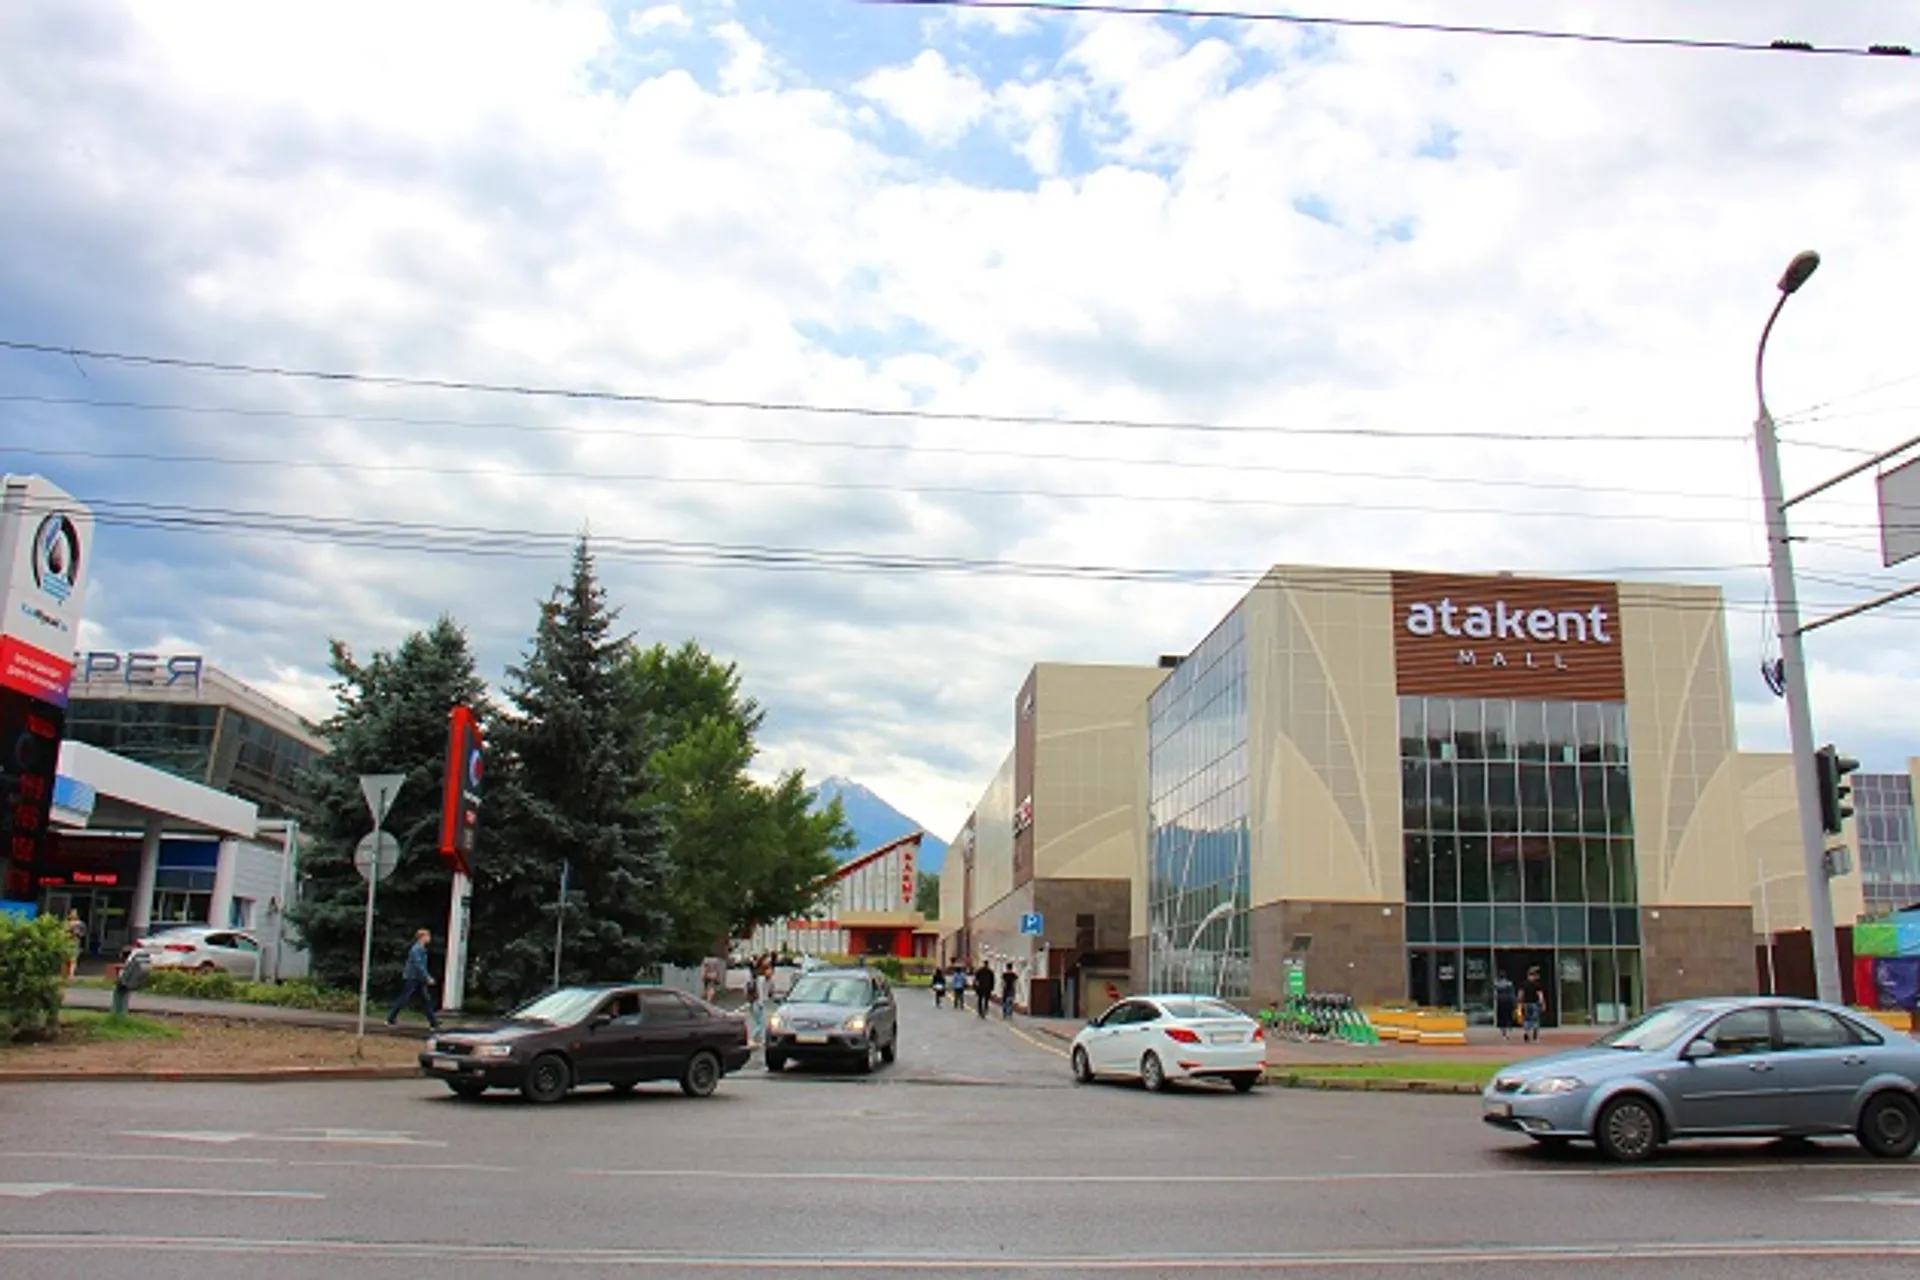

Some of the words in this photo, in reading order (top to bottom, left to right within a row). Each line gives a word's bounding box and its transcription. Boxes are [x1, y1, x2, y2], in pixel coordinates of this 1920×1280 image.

[1406, 598, 1612, 643] atakent
[74, 651, 203, 689] РЕЯ
[1457, 649, 1568, 670] MALL
